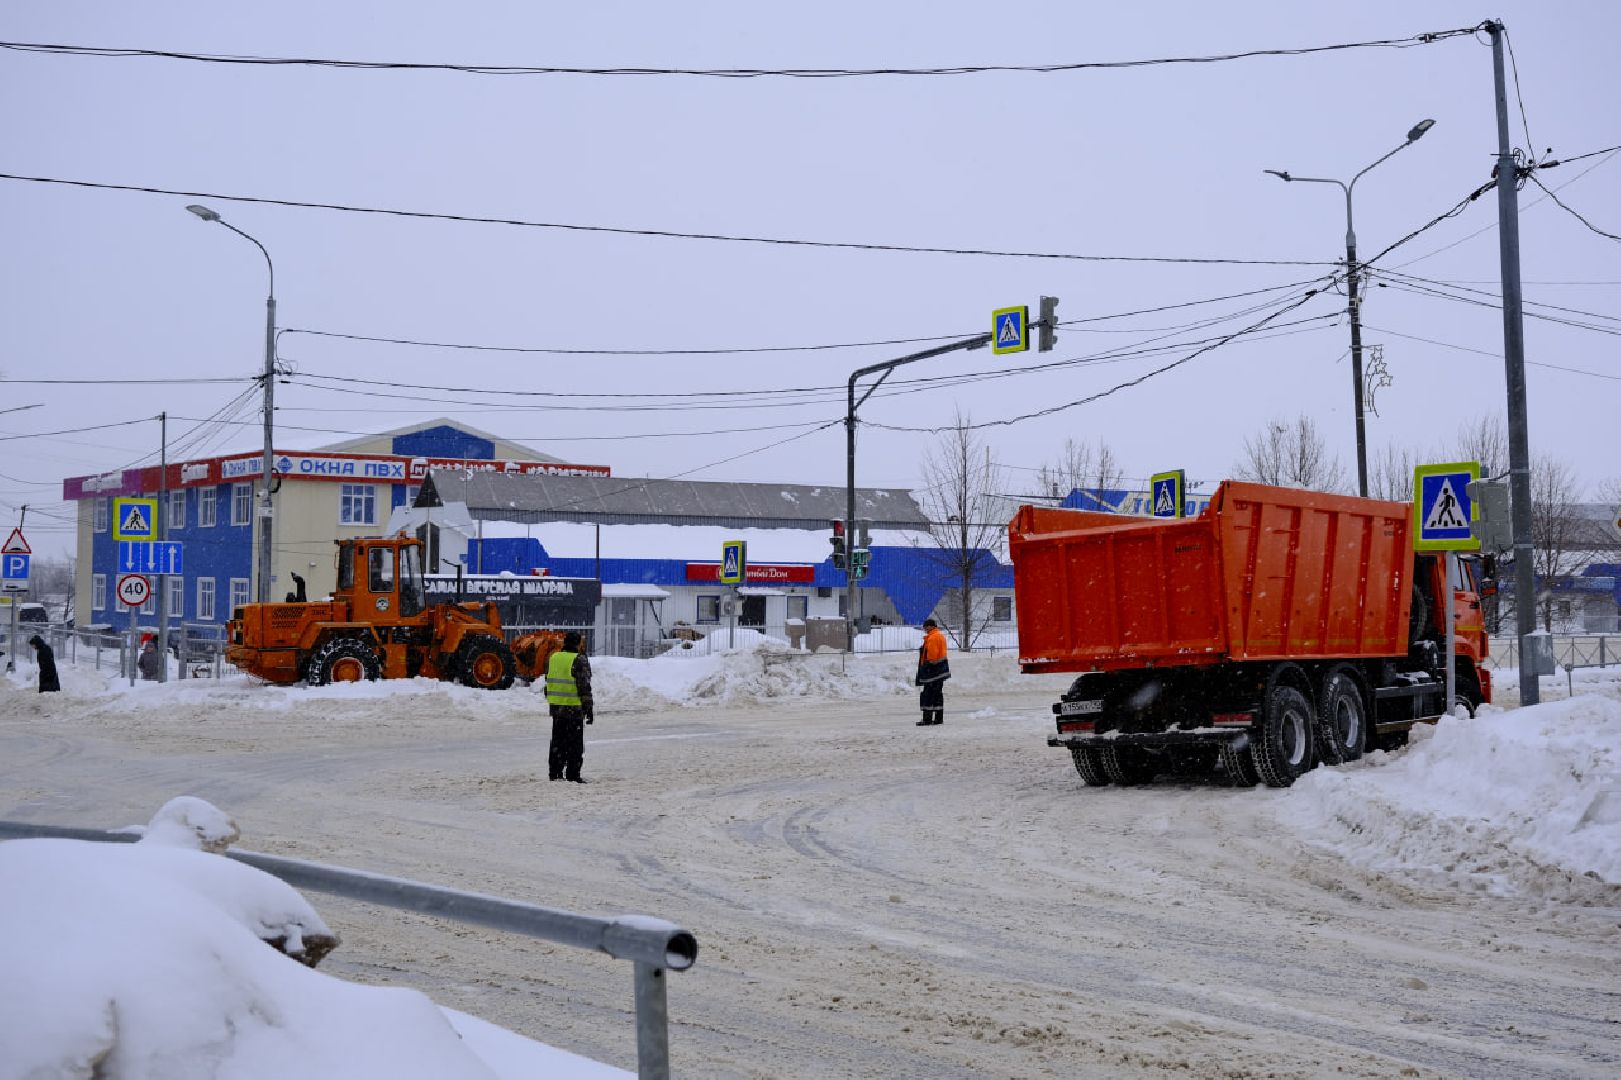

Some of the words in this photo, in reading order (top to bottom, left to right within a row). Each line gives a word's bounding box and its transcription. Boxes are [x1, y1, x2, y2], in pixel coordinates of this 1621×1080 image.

[300, 459, 355, 475] ОКНА
[364, 463, 403, 478] ПВХ
[124, 582, 144, 596] 40
